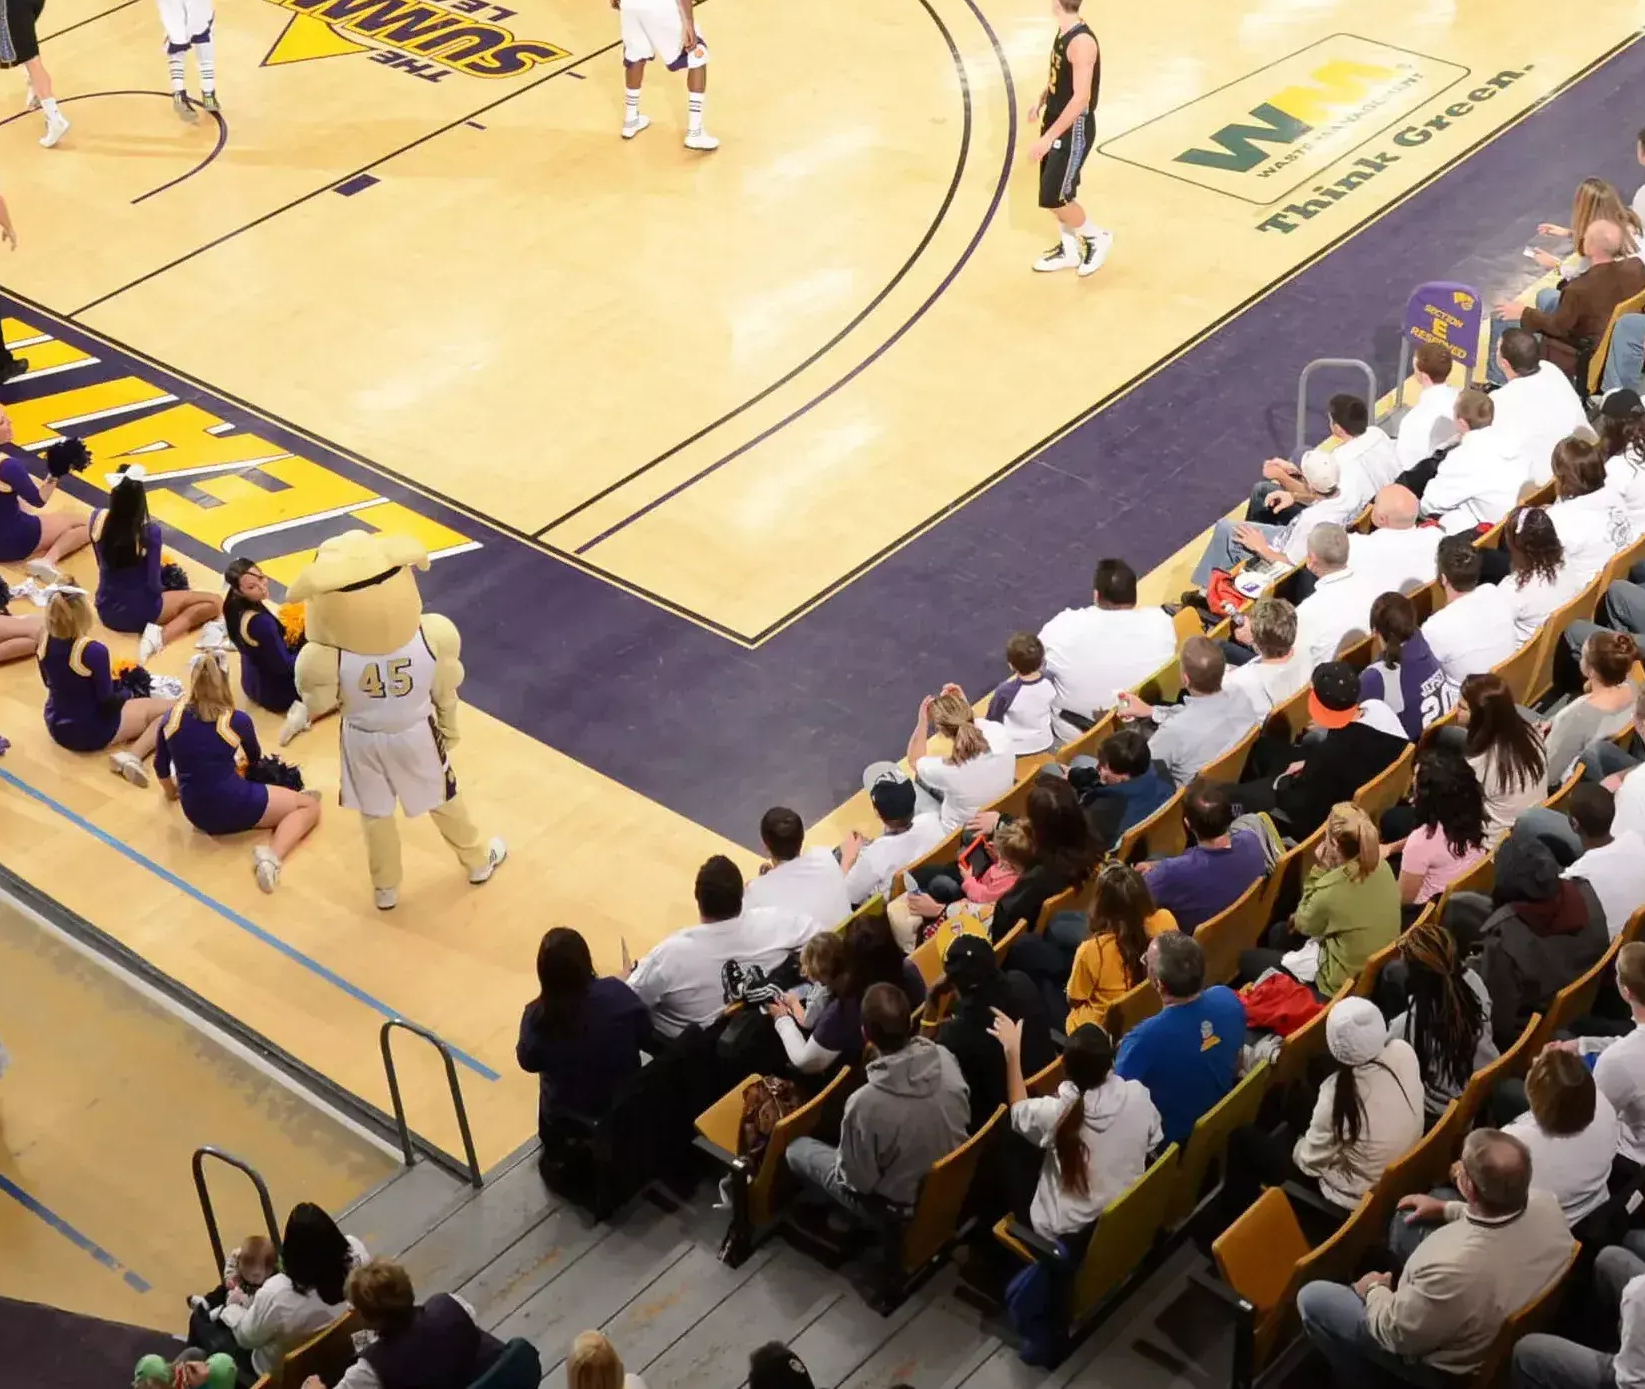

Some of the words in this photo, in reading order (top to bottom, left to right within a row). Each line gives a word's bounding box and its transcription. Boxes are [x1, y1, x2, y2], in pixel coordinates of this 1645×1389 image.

[369, 48, 456, 86] THE
[1172, 58, 1398, 174] WM
[1253, 149, 1402, 236] Think
[1392, 62, 1538, 150] Green.
[1423, 302, 1464, 330] SECTION
[1433, 317, 1450, 341] E
[357, 657, 414, 699] 45
